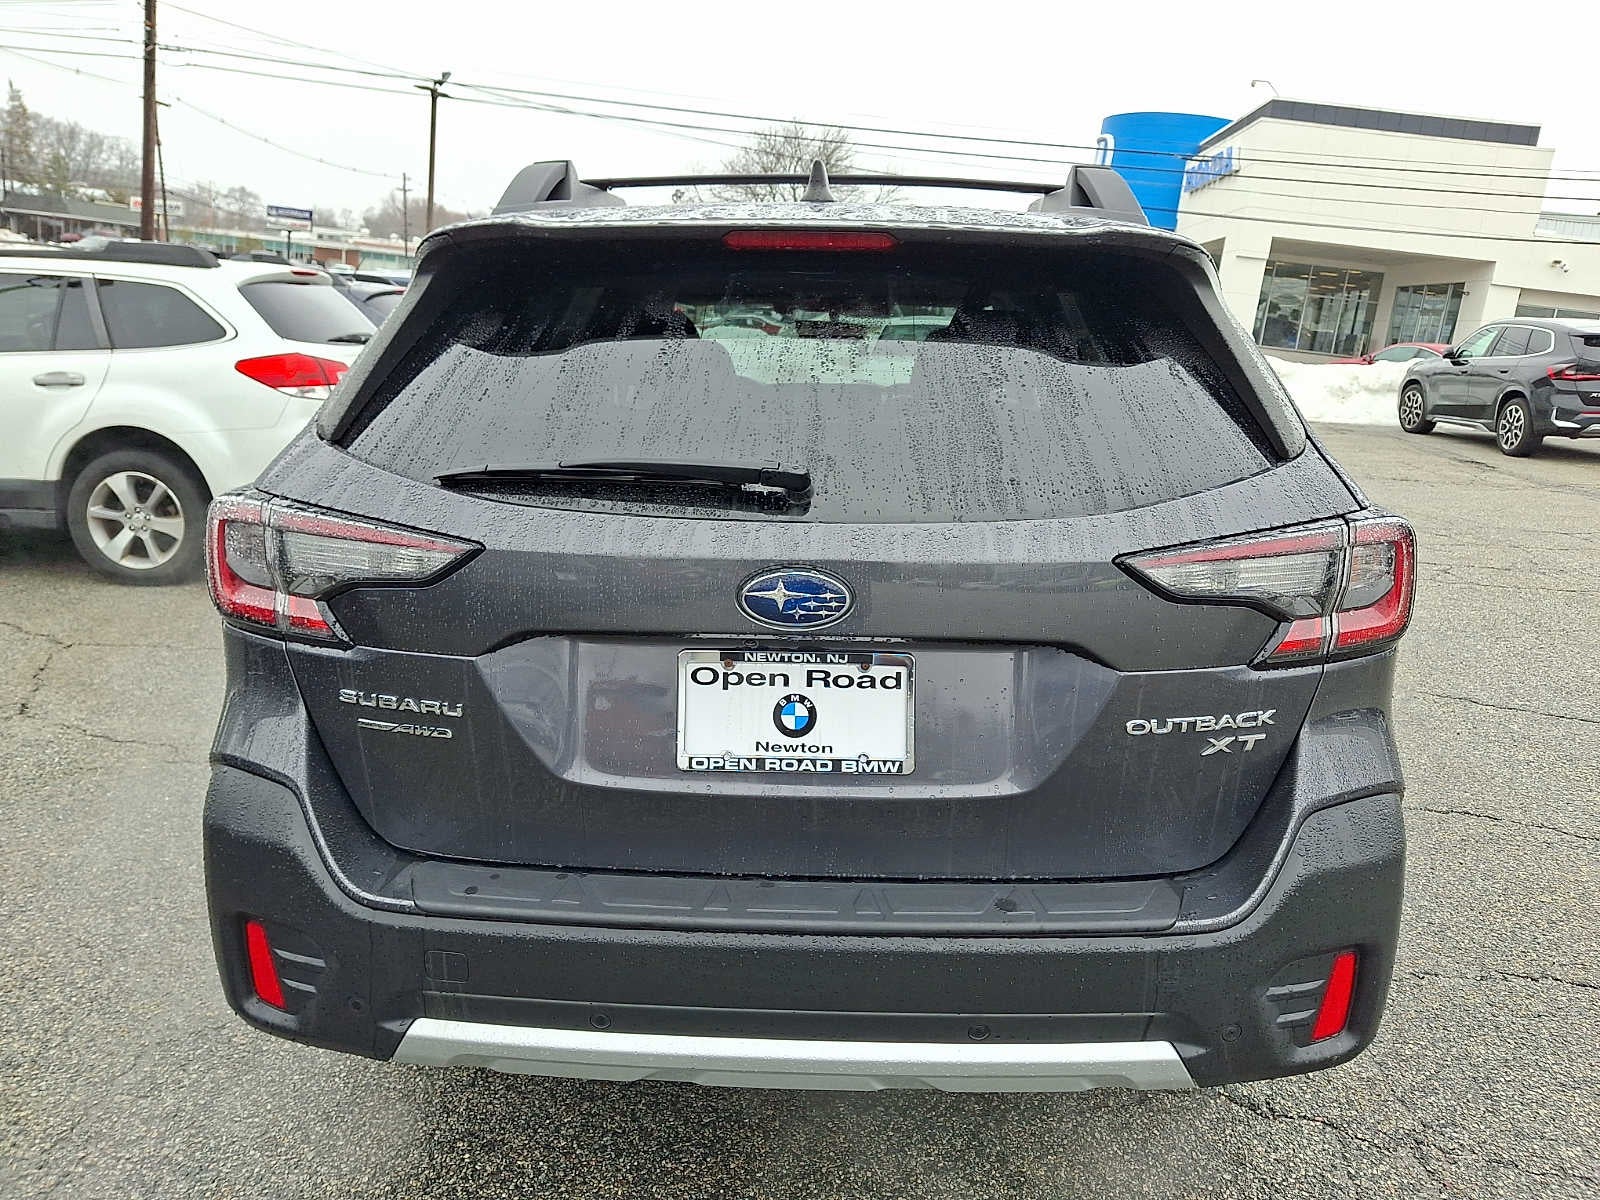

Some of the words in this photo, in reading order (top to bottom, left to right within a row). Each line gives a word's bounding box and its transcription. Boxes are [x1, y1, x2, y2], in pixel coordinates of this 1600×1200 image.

[826, 653, 849, 664] NJ
[690, 666, 790, 690] Open
[806, 669, 902, 690] Road
[339, 689, 463, 717] SUBARU
[779, 694, 813, 708] BMW
[1125, 709, 1277, 735] OUTBACK
[391, 723, 453, 739] AWD
[755, 741, 833, 754] Newton
[1200, 732, 1267, 756] XT
[691, 757, 757, 771] OPEN
[764, 759, 833, 772] ROAD
[840, 760, 901, 773] BMW
